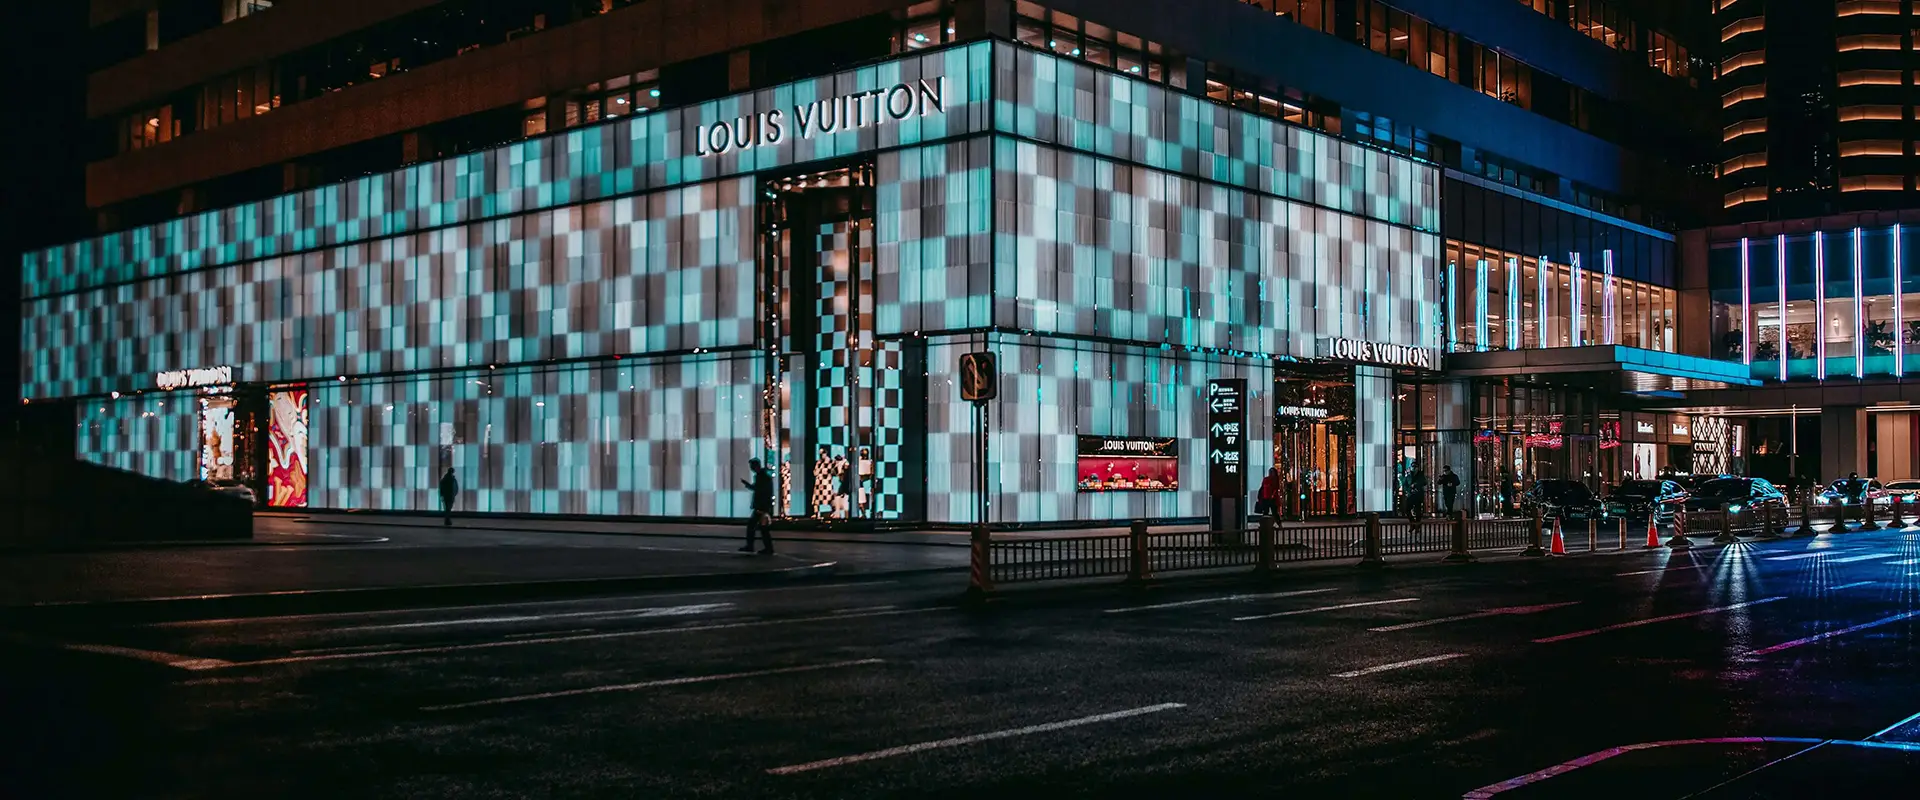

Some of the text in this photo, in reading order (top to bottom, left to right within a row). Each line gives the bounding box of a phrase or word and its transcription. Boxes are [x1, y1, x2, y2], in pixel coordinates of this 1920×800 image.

[696, 76, 945, 156] LOUIS VUITTON
[1329, 337, 1429, 367] LOUIS VUITTON
[1211, 383, 1218, 396] P
[1223, 423, 1239, 432] 中区
[1226, 436, 1236, 444] 97
[1103, 440, 1155, 451] LOUIS VUITTON
[1223, 451, 1239, 461] 北区
[1225, 464, 1237, 473] 141
